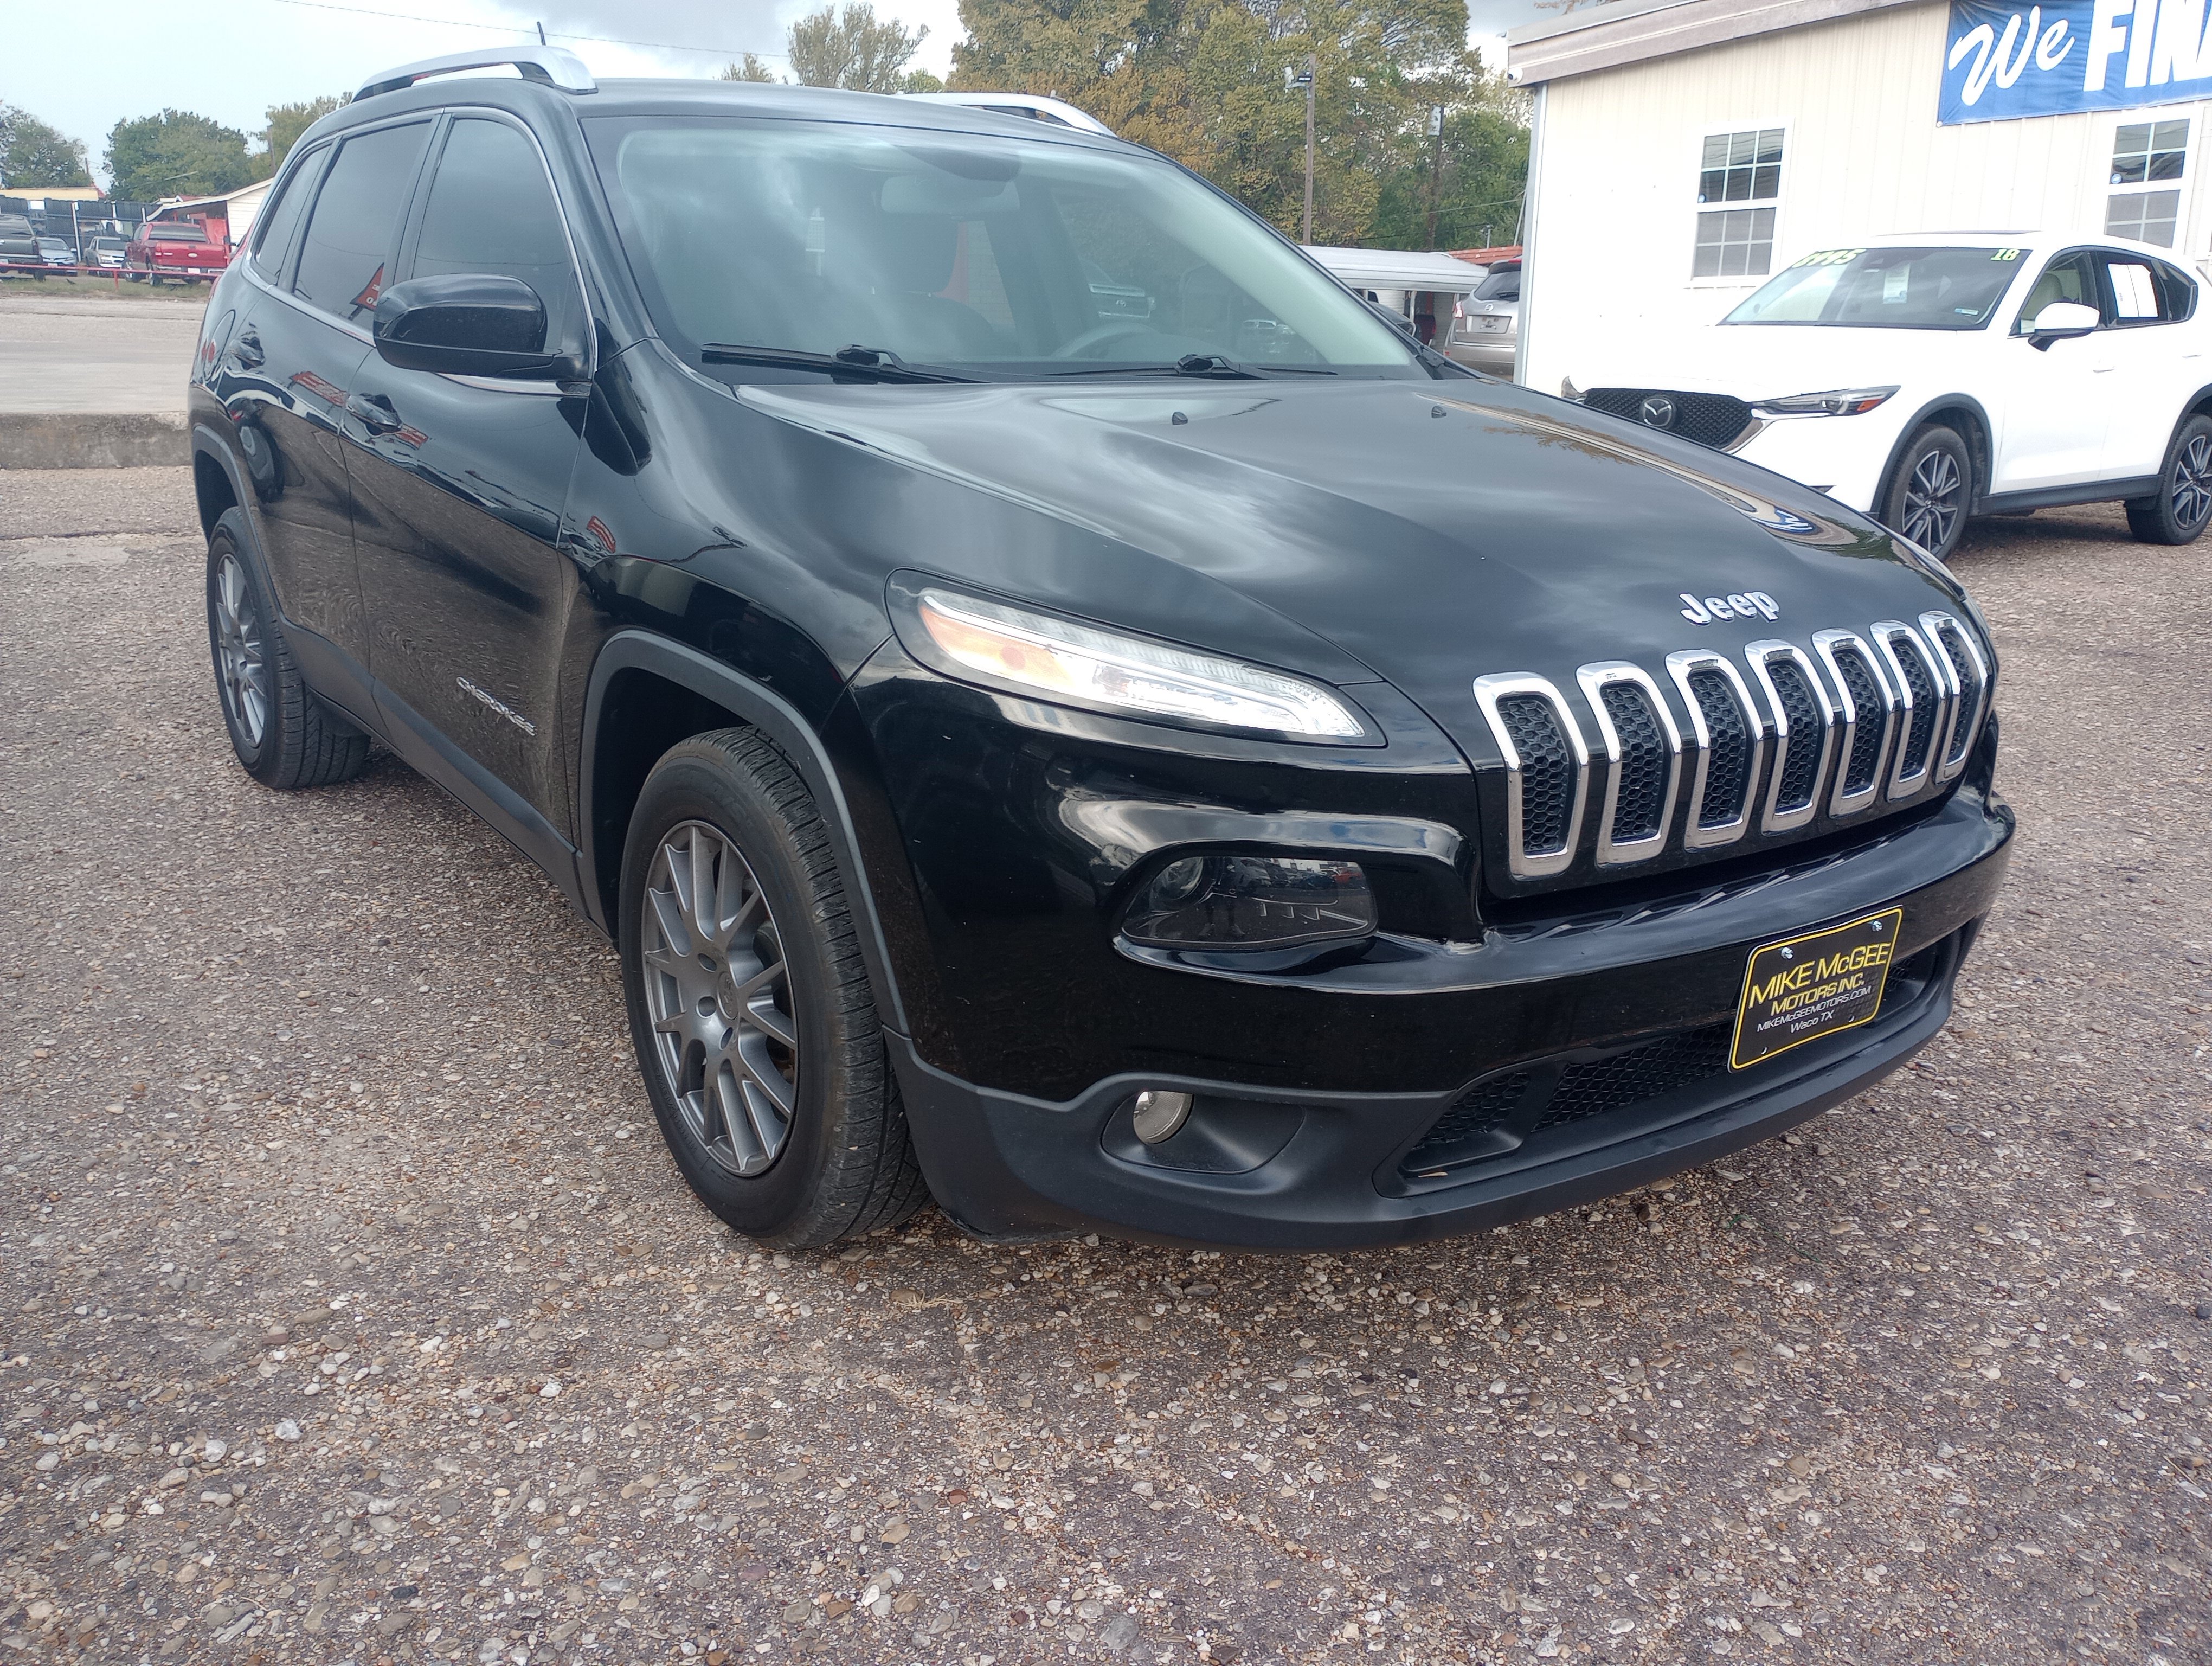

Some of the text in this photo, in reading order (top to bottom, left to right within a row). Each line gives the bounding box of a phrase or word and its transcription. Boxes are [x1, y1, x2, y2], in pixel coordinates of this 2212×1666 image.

[1948, 0, 2212, 106] We FIN
[1990, 249, 2020, 261] 18
[1679, 590, 1780, 625] Jeep
[456, 677, 538, 736] CHEROKEE
[1748, 942, 1892, 1009] MIKE McGEE
[1770, 972, 1865, 1016] MOTORS INC.
[1790, 1009, 1835, 1034] Waco TX
